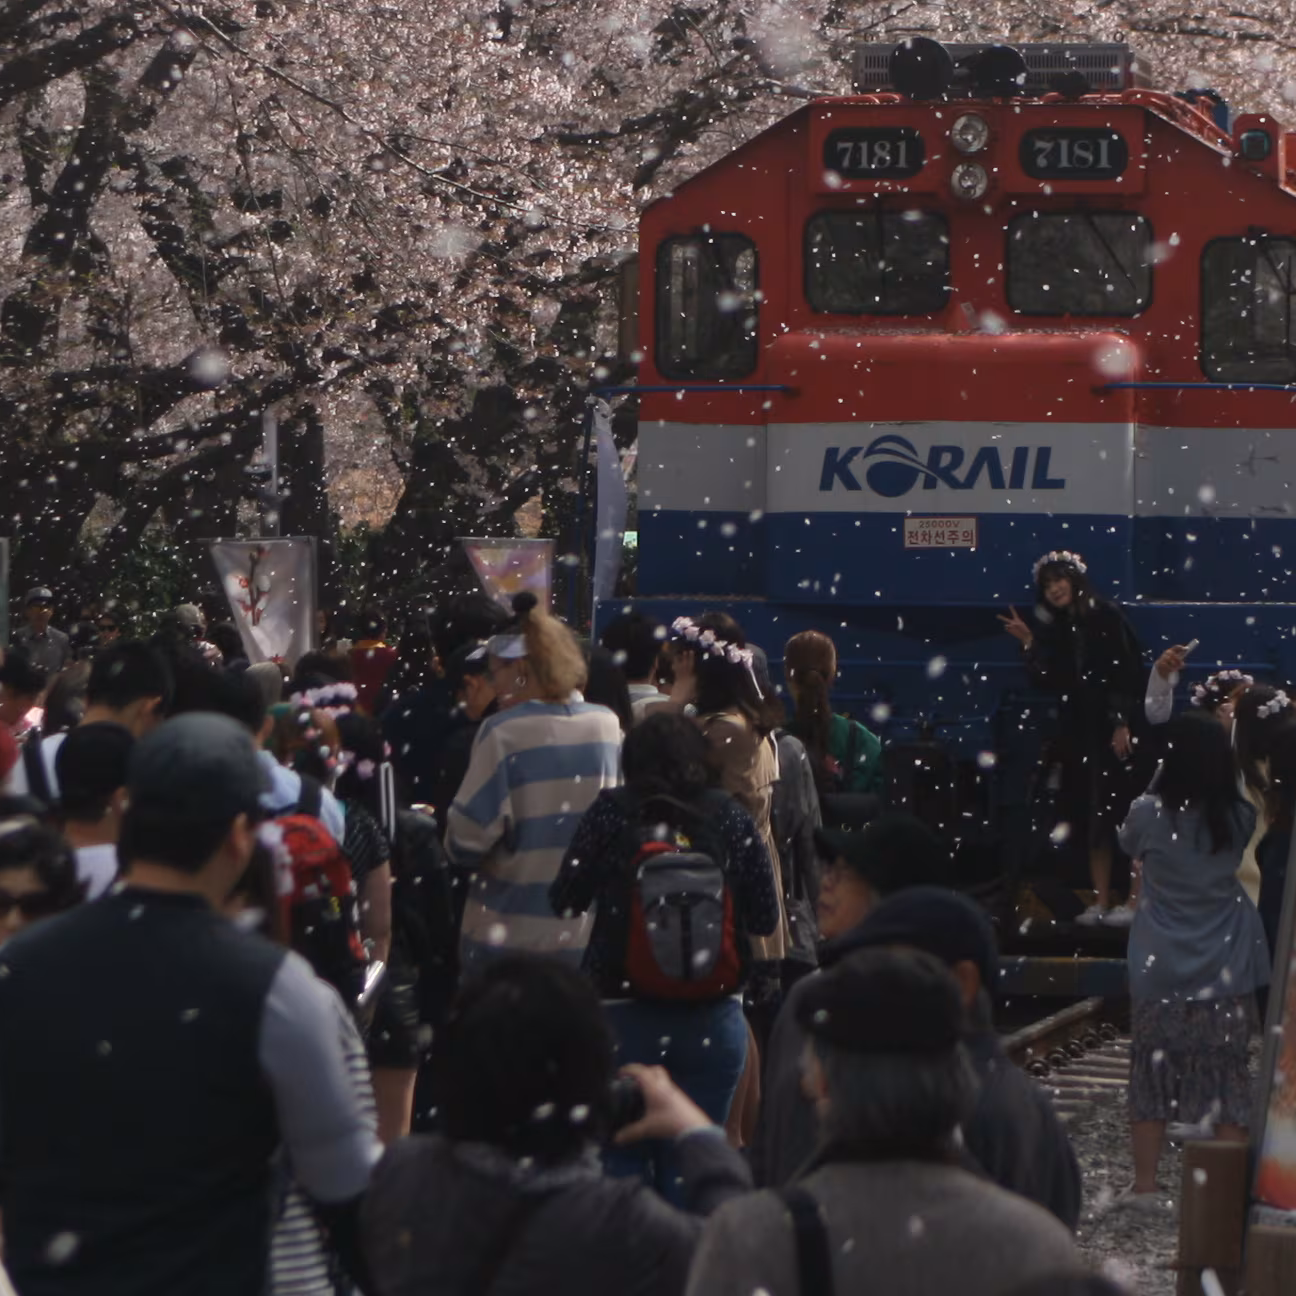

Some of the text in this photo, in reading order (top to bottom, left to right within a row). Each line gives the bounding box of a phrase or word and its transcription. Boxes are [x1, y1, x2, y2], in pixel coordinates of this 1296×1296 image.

[836, 140, 910, 169] 7181
[1032, 138, 1113, 169] 7181
[819, 434, 1066, 498] KORAIL
[907, 529, 974, 545] 전차선주의
